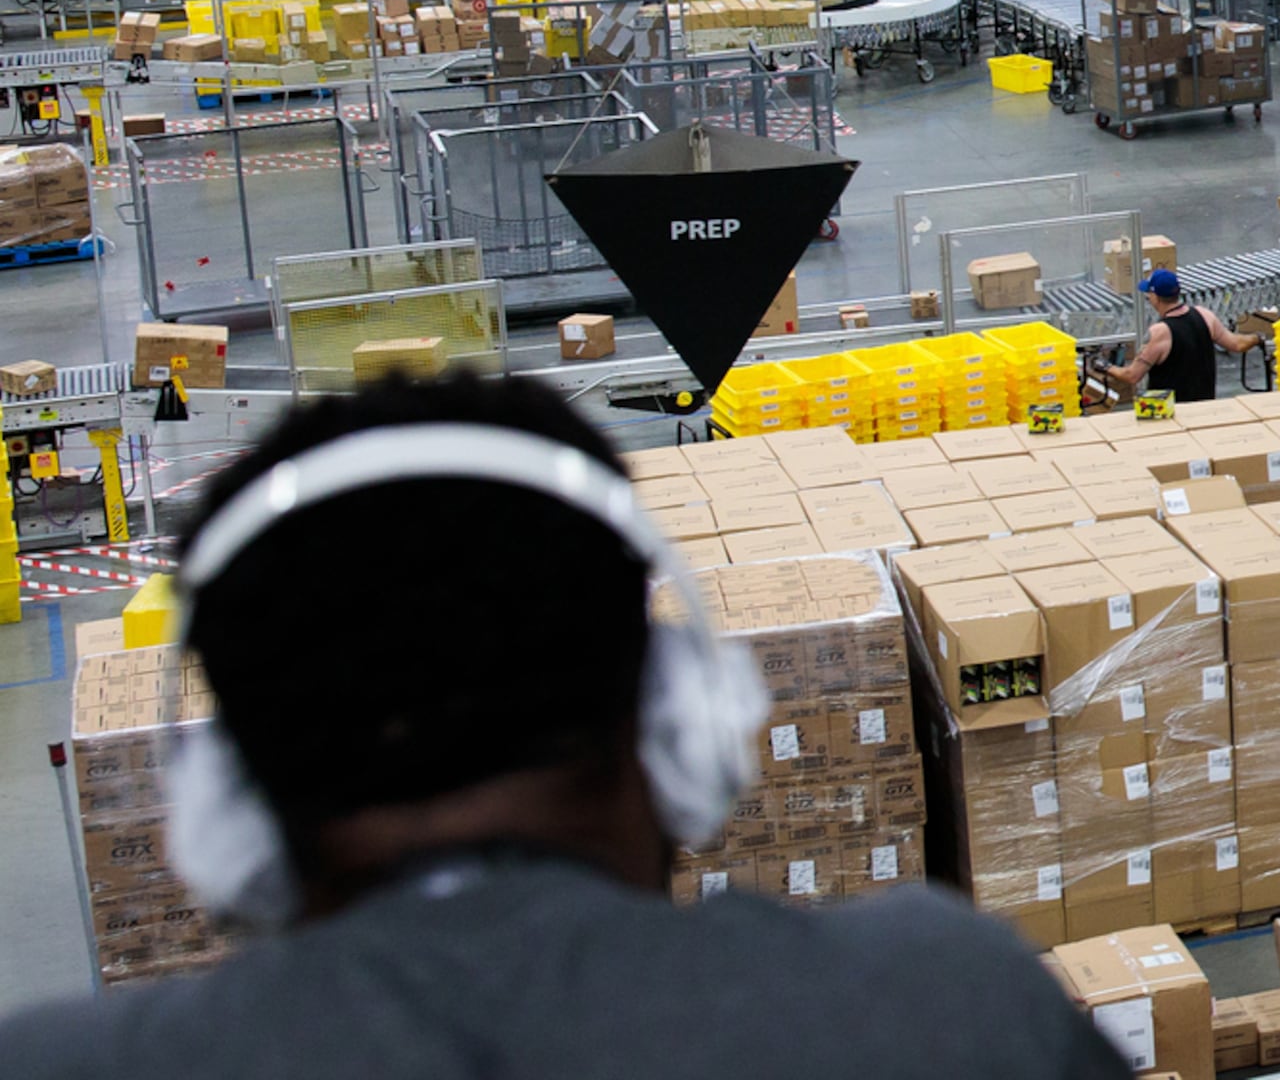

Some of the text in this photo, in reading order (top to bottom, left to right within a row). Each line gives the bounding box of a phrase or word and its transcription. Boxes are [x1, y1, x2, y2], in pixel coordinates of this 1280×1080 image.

[670, 218, 741, 240] PREP
[764, 658, 794, 670] GTX
[885, 783, 915, 796] GTX
[111, 841, 154, 858] GTX
